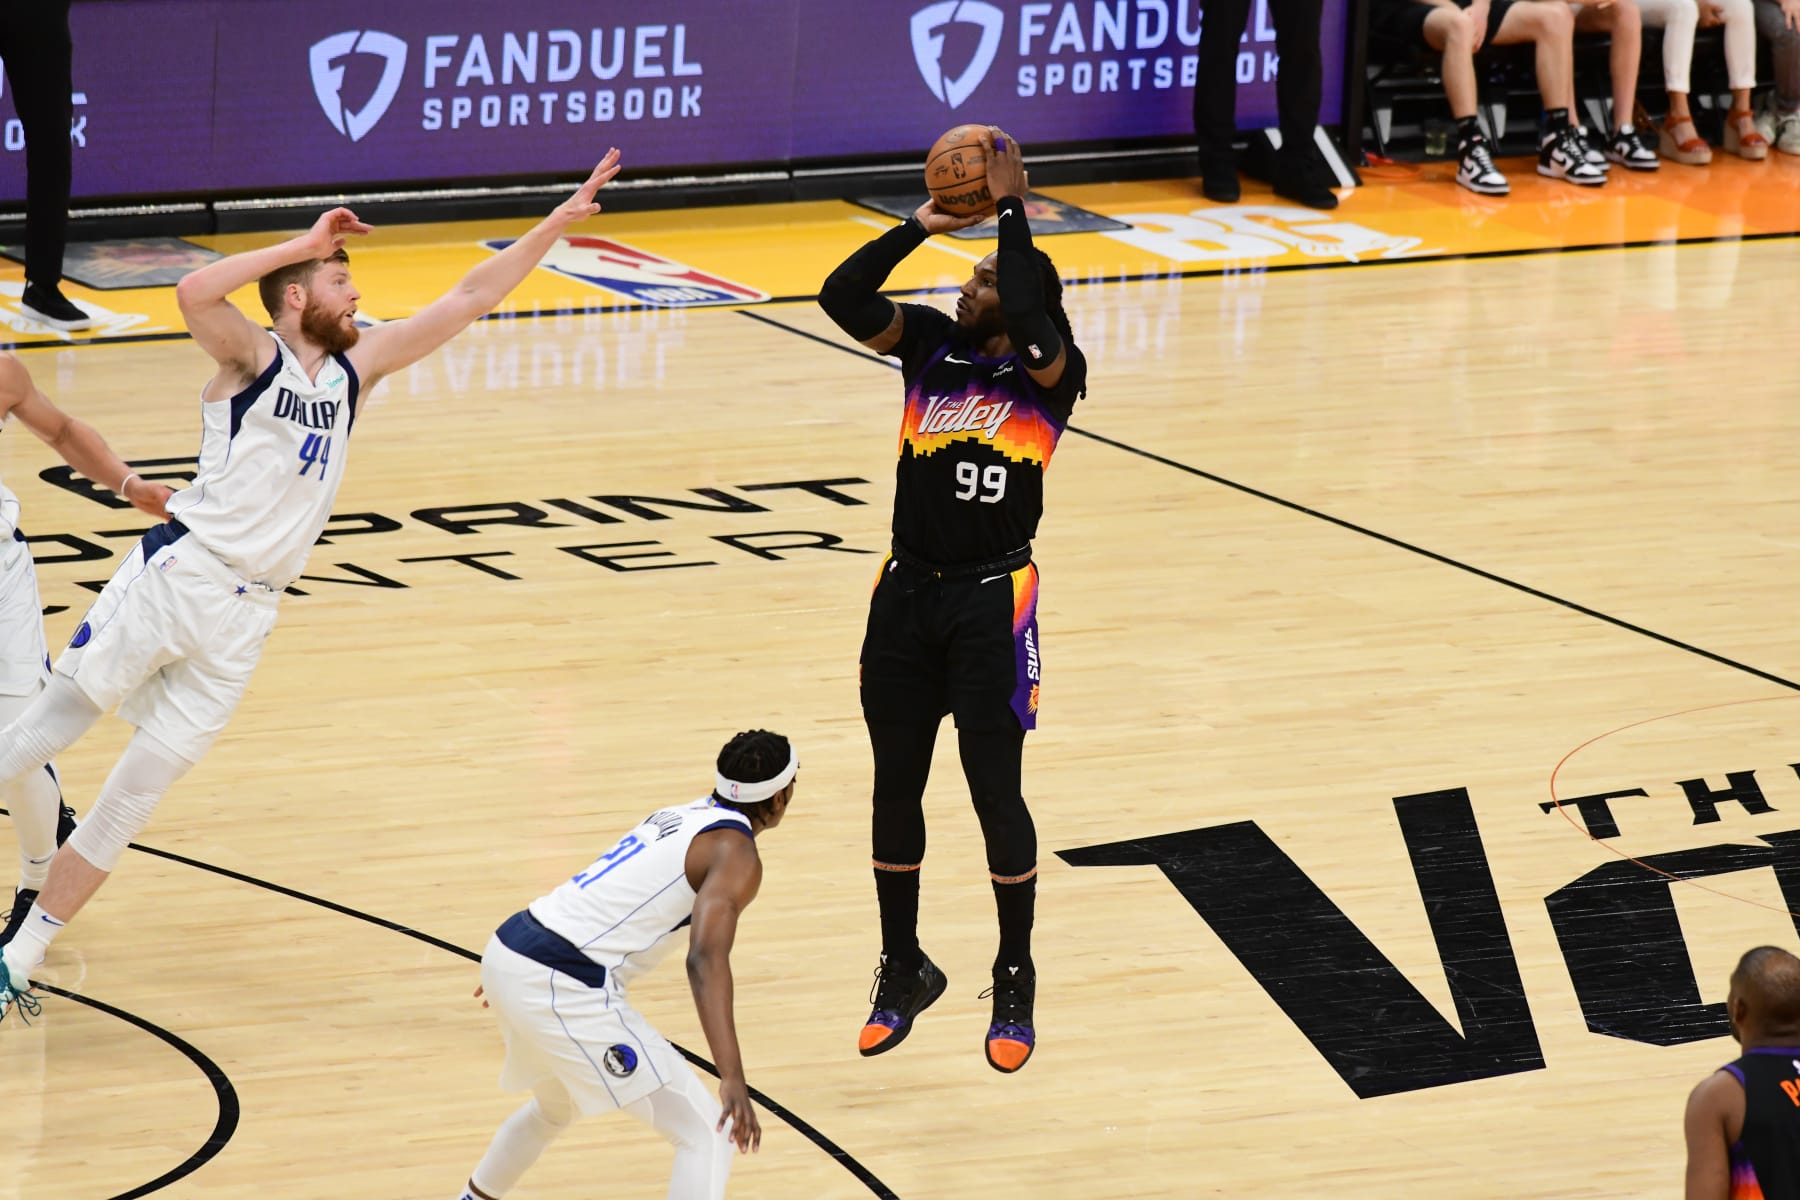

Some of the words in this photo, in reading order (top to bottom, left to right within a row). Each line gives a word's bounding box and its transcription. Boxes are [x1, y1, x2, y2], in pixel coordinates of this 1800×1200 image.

[1018, 0, 1277, 56] FANDUL
[423, 23, 703, 89] FANDUEL
[1017, 51, 1280, 97] SPORTSBOK
[422, 85, 703, 130] SPORTSBOOK
[917, 396, 1014, 440] Valley
[298, 432, 332, 481] 44
[955, 461, 1008, 504] 99
[1024, 626, 1040, 681] SUNS
[1538, 762, 1800, 841] TH
